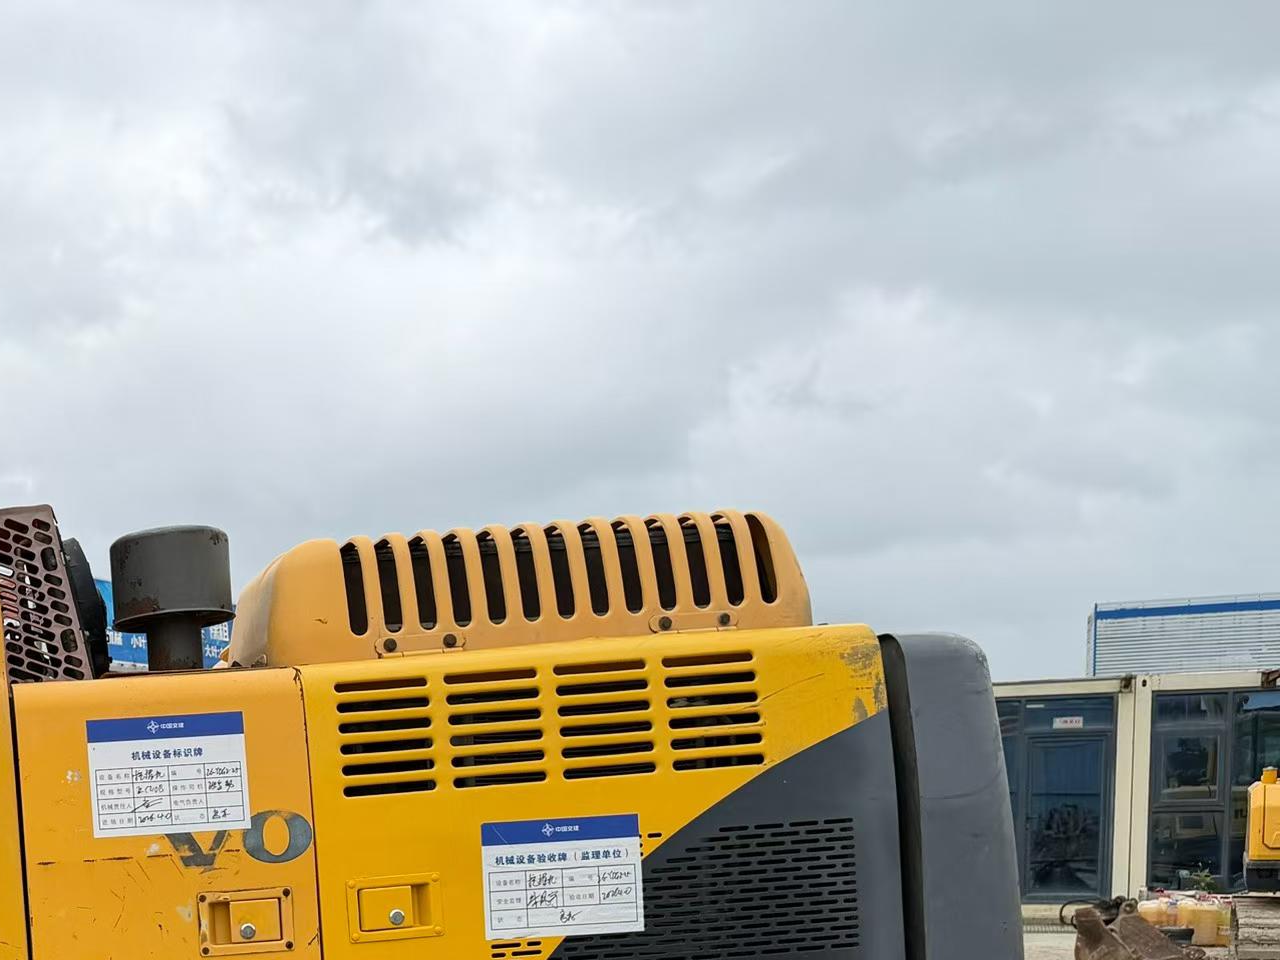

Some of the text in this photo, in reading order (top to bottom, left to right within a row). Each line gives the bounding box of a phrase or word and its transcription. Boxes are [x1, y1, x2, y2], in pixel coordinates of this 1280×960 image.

[131, 747, 203, 760] 机械设备标识牌
